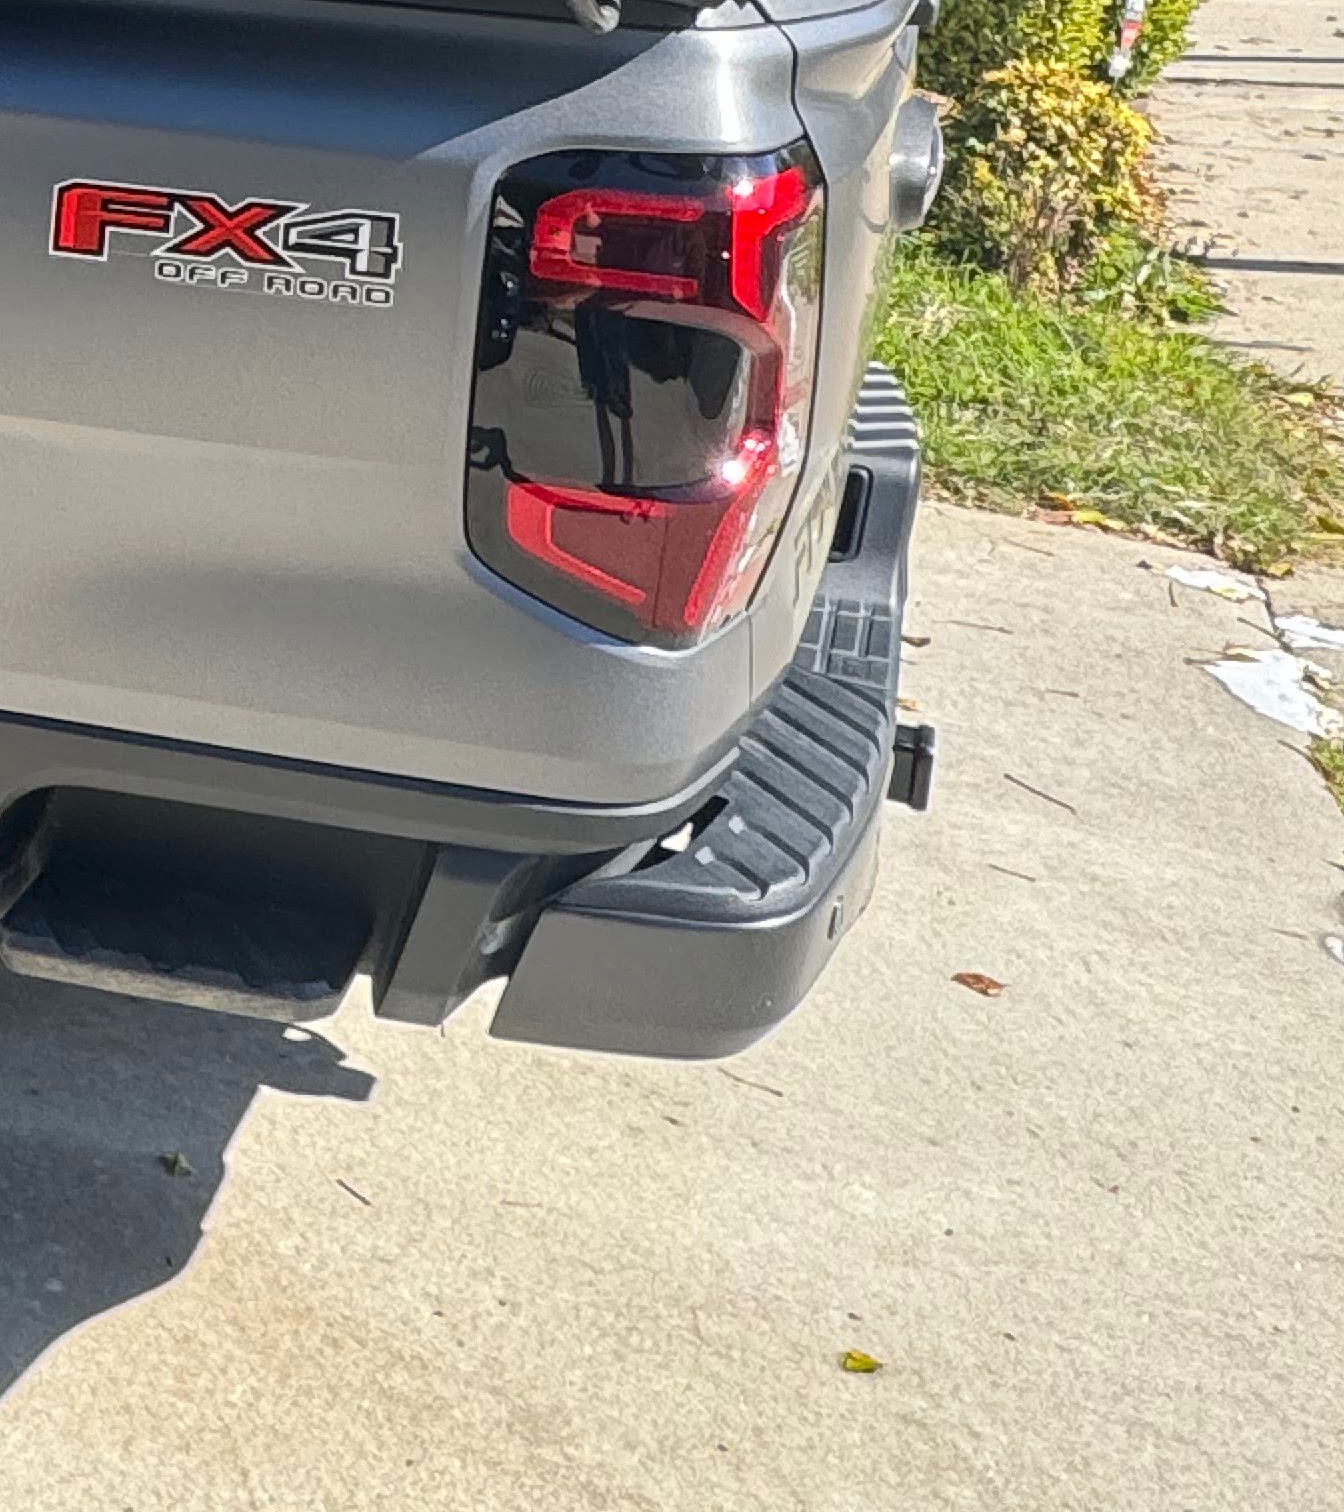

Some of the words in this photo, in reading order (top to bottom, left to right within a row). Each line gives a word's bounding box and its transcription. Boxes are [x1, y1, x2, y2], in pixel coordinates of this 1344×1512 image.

[49, 178, 404, 284] FX4
[154, 260, 249, 289] OFF
[262, 272, 395, 308] ROAD
